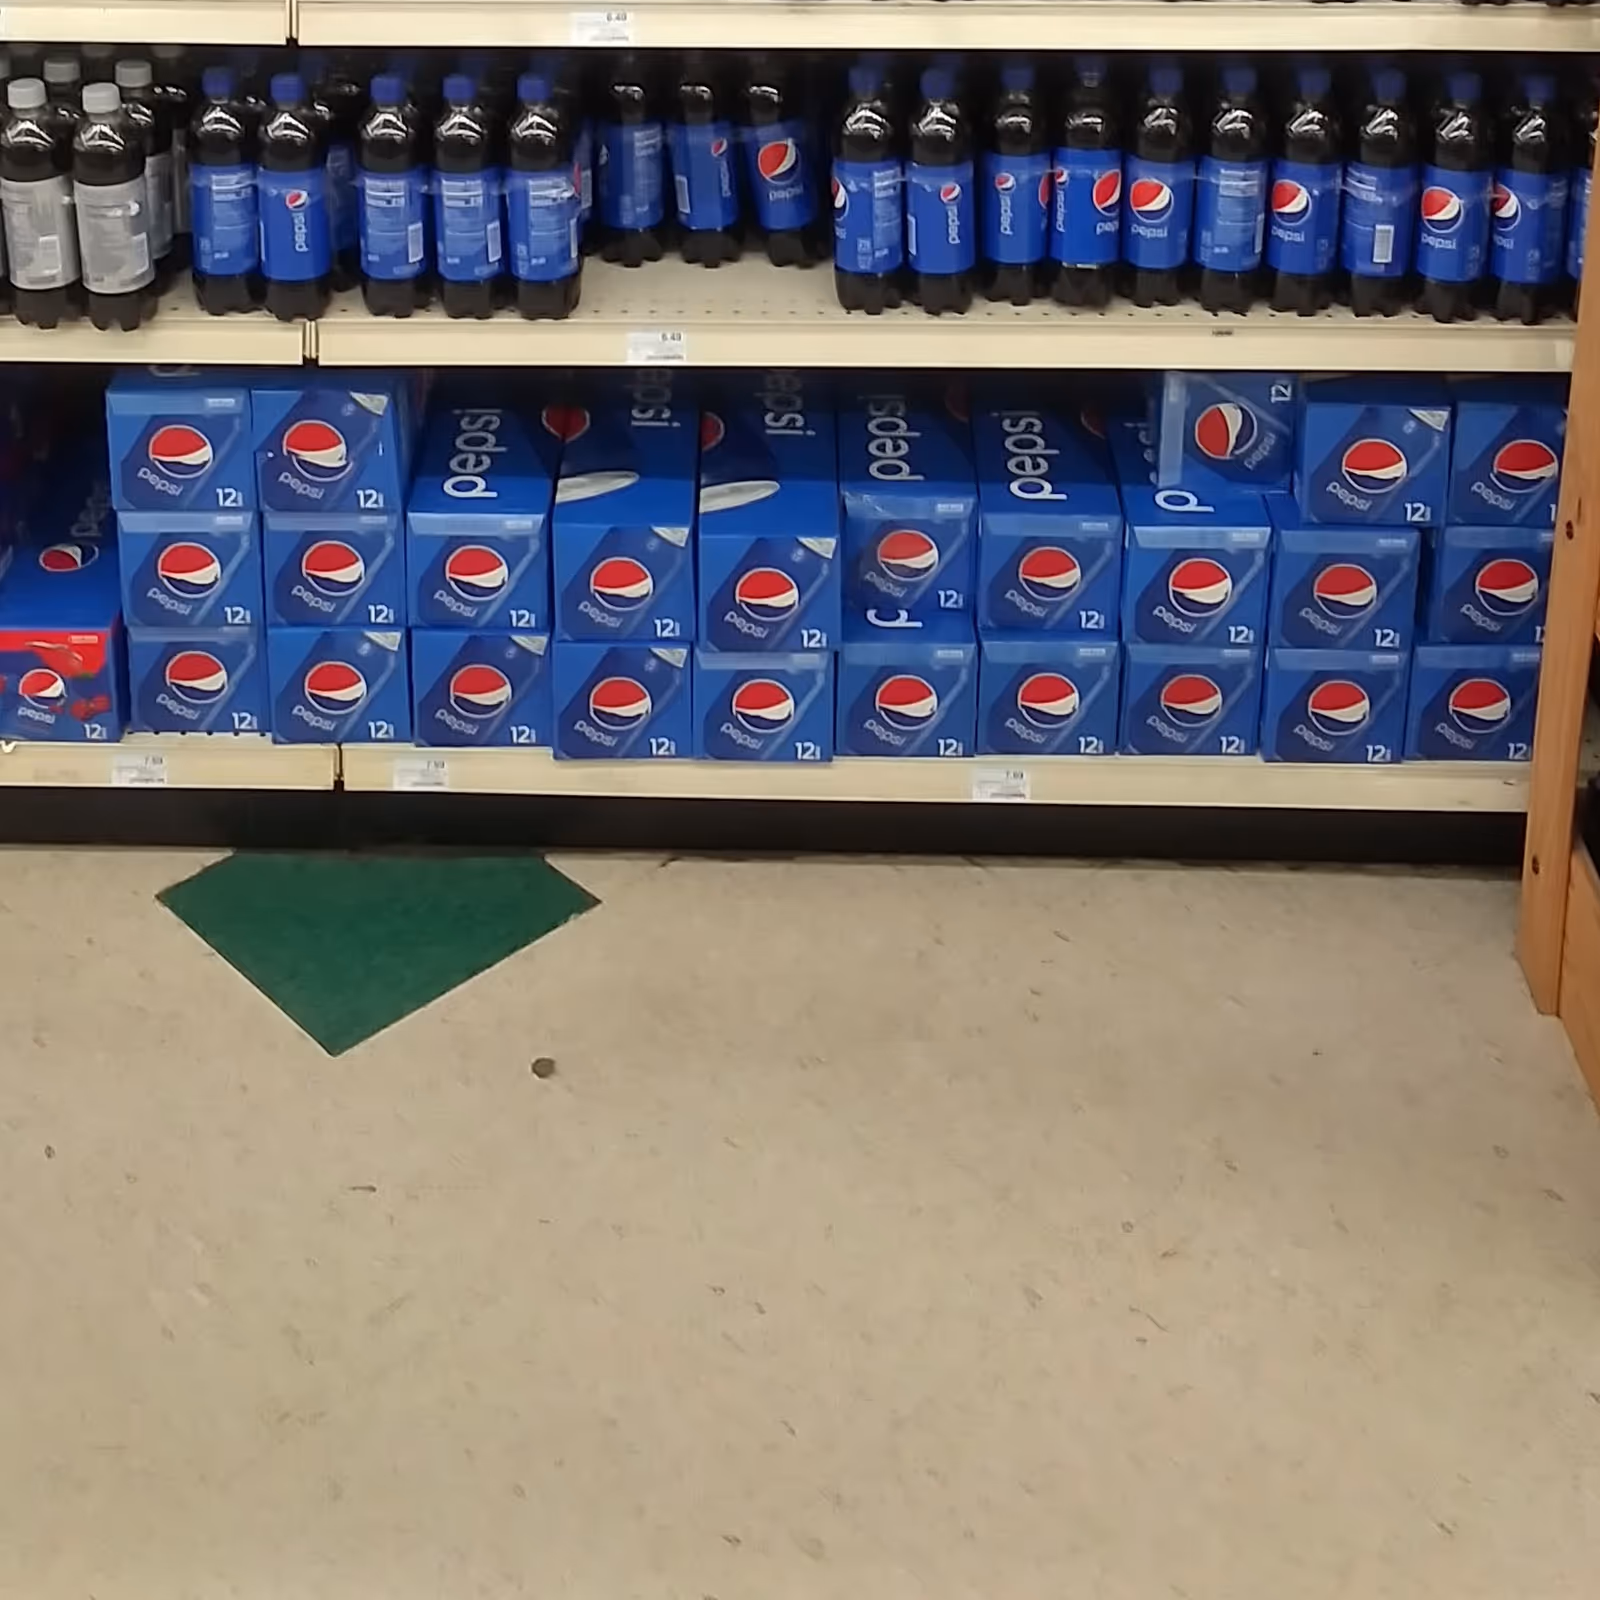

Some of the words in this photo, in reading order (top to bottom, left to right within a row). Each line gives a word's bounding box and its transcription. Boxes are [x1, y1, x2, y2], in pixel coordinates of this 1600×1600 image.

[949, 205, 961, 244] pepsi
[1000, 194, 1013, 236] pepsi
[1096, 222, 1119, 234] pep
[292, 212, 309, 252] pepsi
[1271, 383, 1291, 403] 12
[443, 408, 507, 498] pepsi
[992, 411, 1068, 501] pepsi
[1244, 433, 1276, 470] pepsi
[138, 467, 183, 496] pepsi
[279, 471, 325, 499] pepsi
[1471, 480, 1515, 510] pepsi
[217, 488, 237, 507] 12
[357, 490, 378, 508] 12
[1326, 480, 1372, 511] pepsi
[1405, 502, 1425, 521] 12
[864, 571, 908, 598] pepsi
[147, 586, 193, 615] pepsi
[292, 584, 336, 613] pepsi
[433, 589, 477, 617] pepsi
[938, 590, 958, 608] 12
[1005, 589, 1049, 617] pepsi
[225, 607, 244, 624] 12
[368, 605, 387, 623] 12
[510, 610, 530, 627] 12
[578, 599, 624, 628] pepsi
[654, 618, 674, 636] 12
[724, 610, 769, 639] pepsi
[1079, 611, 1100, 629] 12
[1153, 605, 1197, 634] pepsi
[1300, 606, 1344, 634] pepsi
[1460, 603, 1504, 631] pepsi
[801, 629, 821, 647] 12
[1228, 626, 1249, 643] 12
[1374, 629, 1394, 647] 12
[18, 704, 56, 724] pepsi
[156, 693, 200, 721] pepsi
[292, 703, 337, 732] pepsi
[84, 723, 100, 739] 12
[232, 713, 251, 729] 12
[368, 722, 387, 738] 12
[435, 708, 478, 735] pepsi
[510, 726, 530, 743] 12
[574, 720, 619, 748] pepsi
[864, 718, 907, 746] pepsi
[1005, 716, 1049, 744] pepsi
[1146, 714, 1190, 743] pepsi
[649, 738, 670, 754] 12
[721, 722, 765, 749] pepsi
[938, 738, 958, 756] 12
[1078, 736, 1099, 754] 12
[1220, 735, 1240, 753] 12
[1294, 723, 1337, 752] pepsi
[1435, 721, 1479, 750] pepsi
[795, 742, 815, 759] 12
[1366, 745, 1386, 762] 12
[1507, 743, 1527, 760] 12
